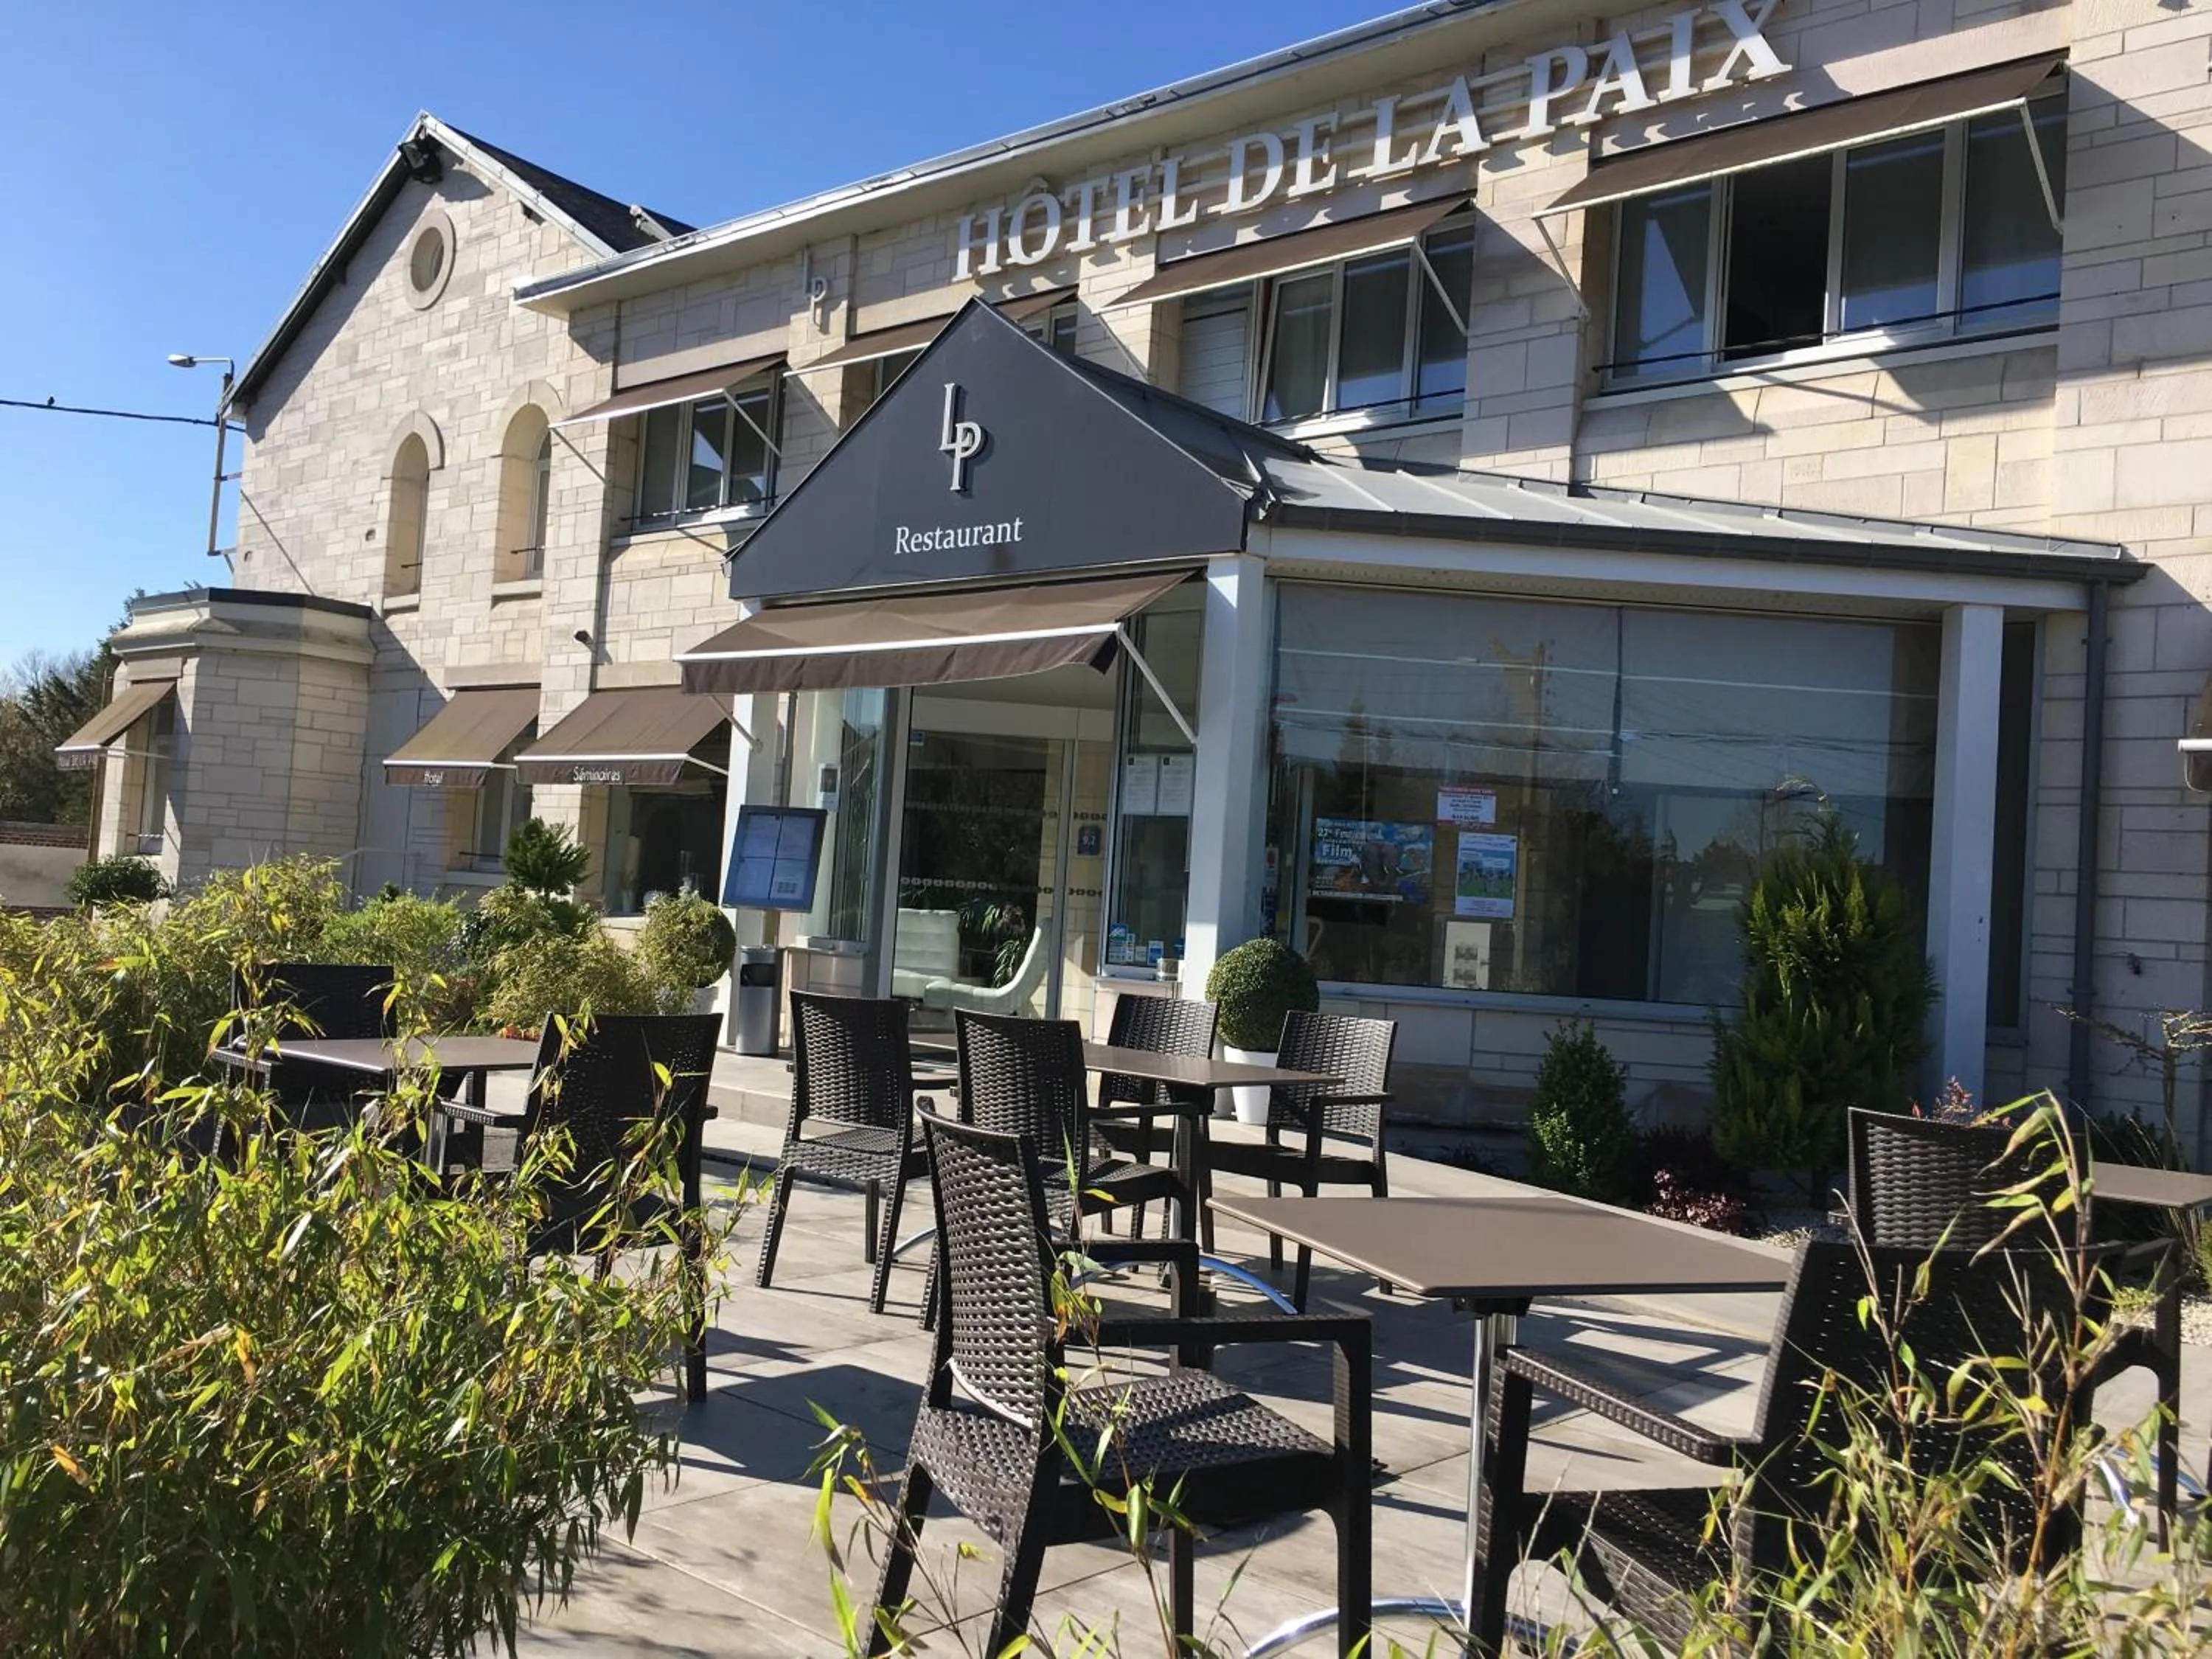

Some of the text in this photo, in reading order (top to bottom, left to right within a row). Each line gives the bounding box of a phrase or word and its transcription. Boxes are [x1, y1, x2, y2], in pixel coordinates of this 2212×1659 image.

[952, 0, 1792, 282] HÔTEL DE LA PAIX
[894, 517, 1023, 554] Restaurant
[1322, 844, 1352, 858] Film
